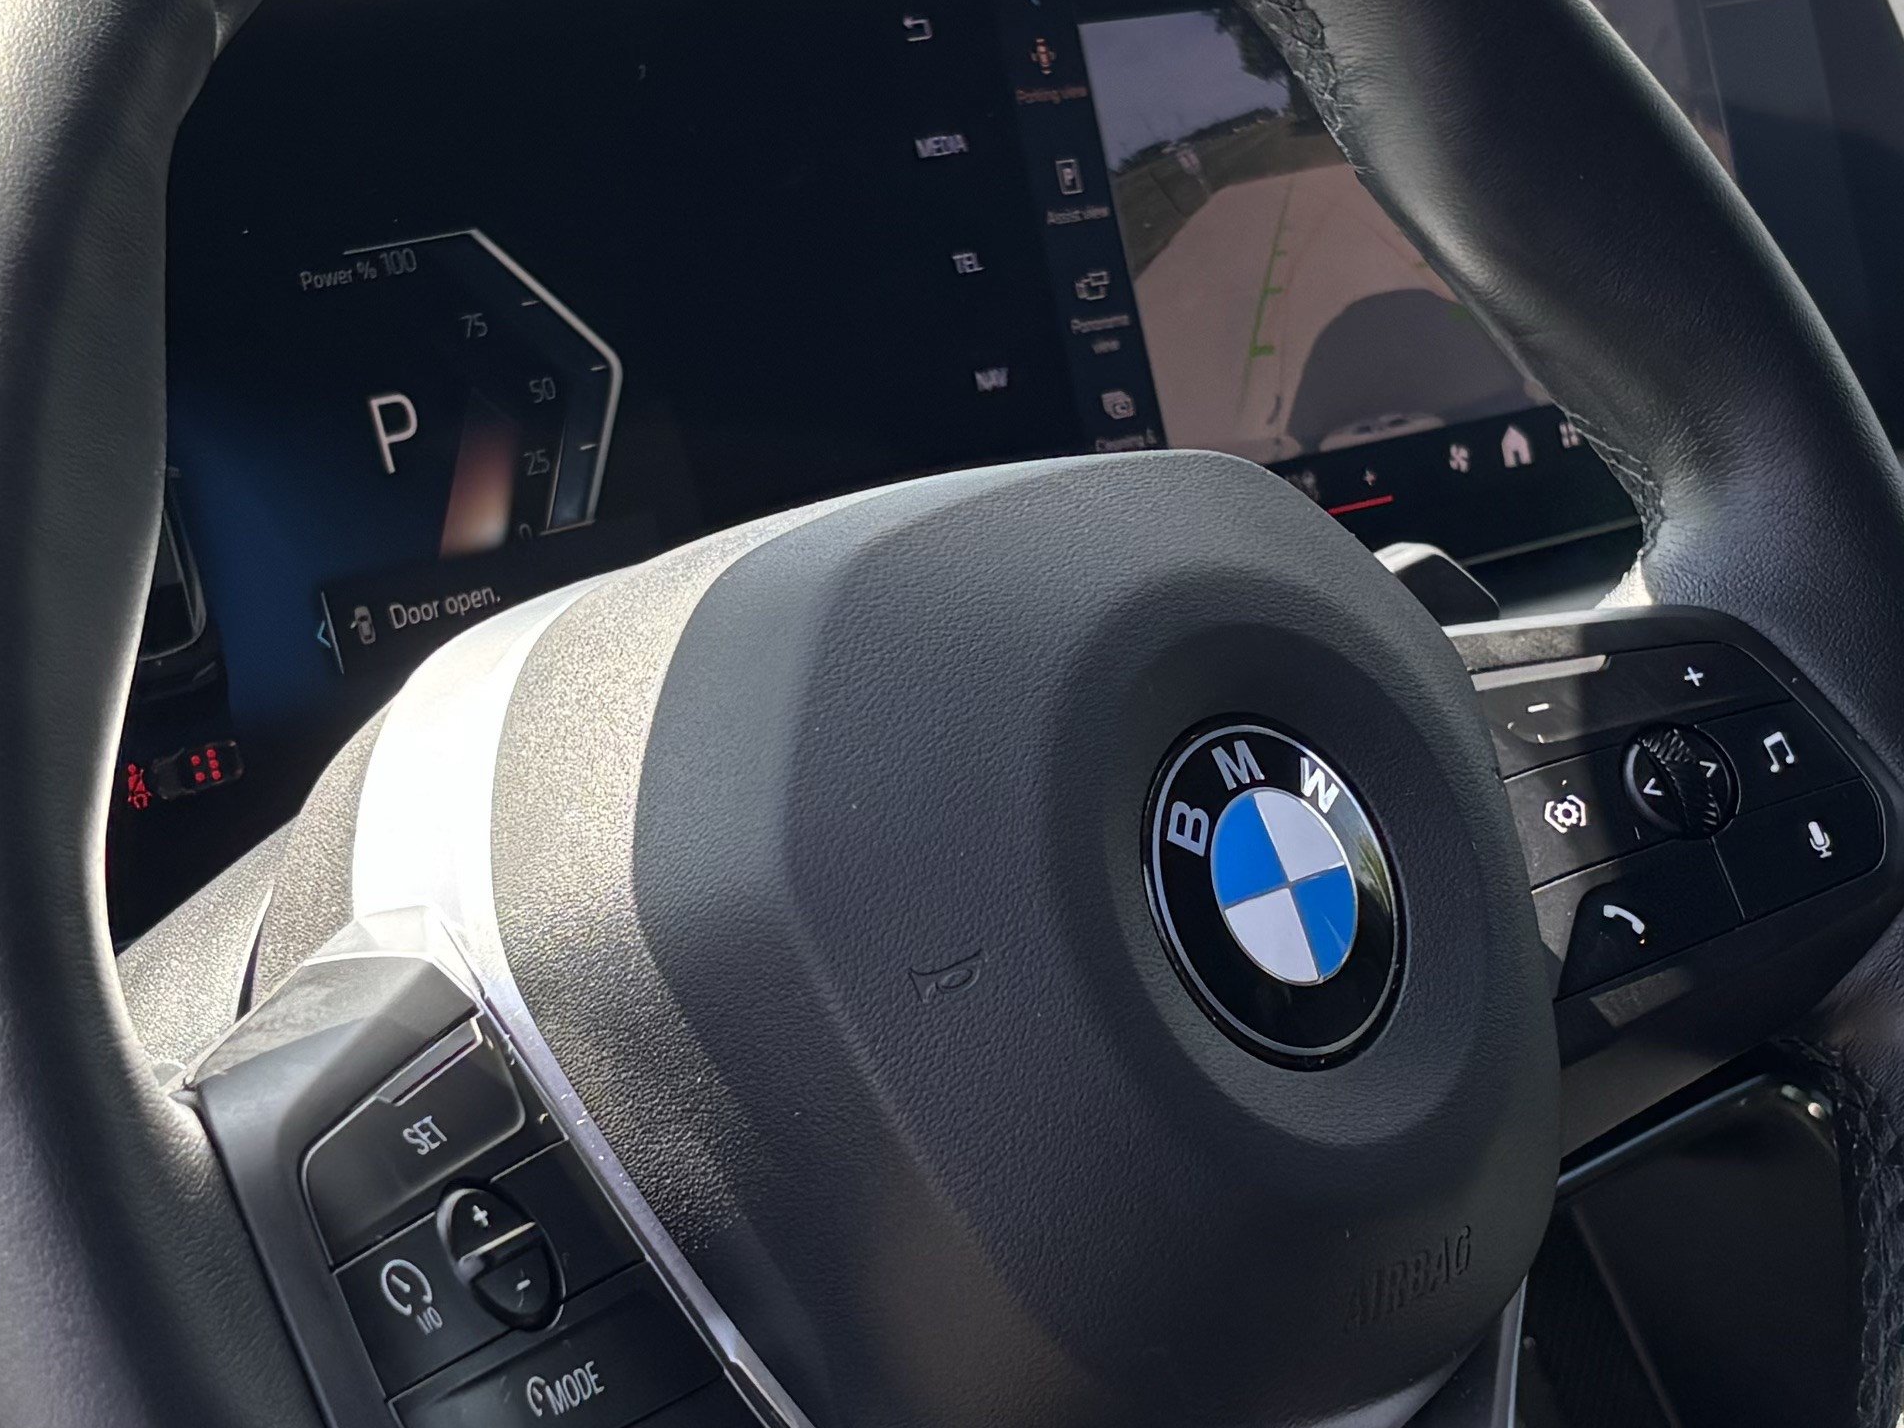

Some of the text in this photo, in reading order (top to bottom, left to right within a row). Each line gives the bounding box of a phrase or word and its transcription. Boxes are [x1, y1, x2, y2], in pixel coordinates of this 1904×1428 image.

[915, 133, 969, 159] MEDIA
[300, 268, 353, 292] Power
[379, 247, 417, 278] 100
[952, 251, 985, 275] TEL
[460, 312, 489, 340] 75
[529, 376, 557, 404] 50
[974, 366, 1009, 393] NAV
[368, 392, 419, 475] P
[523, 449, 552, 477] 25
[389, 584, 502, 631] Door open.
[1167, 739, 1340, 857] BMW
[402, 1114, 448, 1155] SET
[1346, 1224, 1472, 1324] AIRBAG
[540, 1358, 605, 1416] MODE
